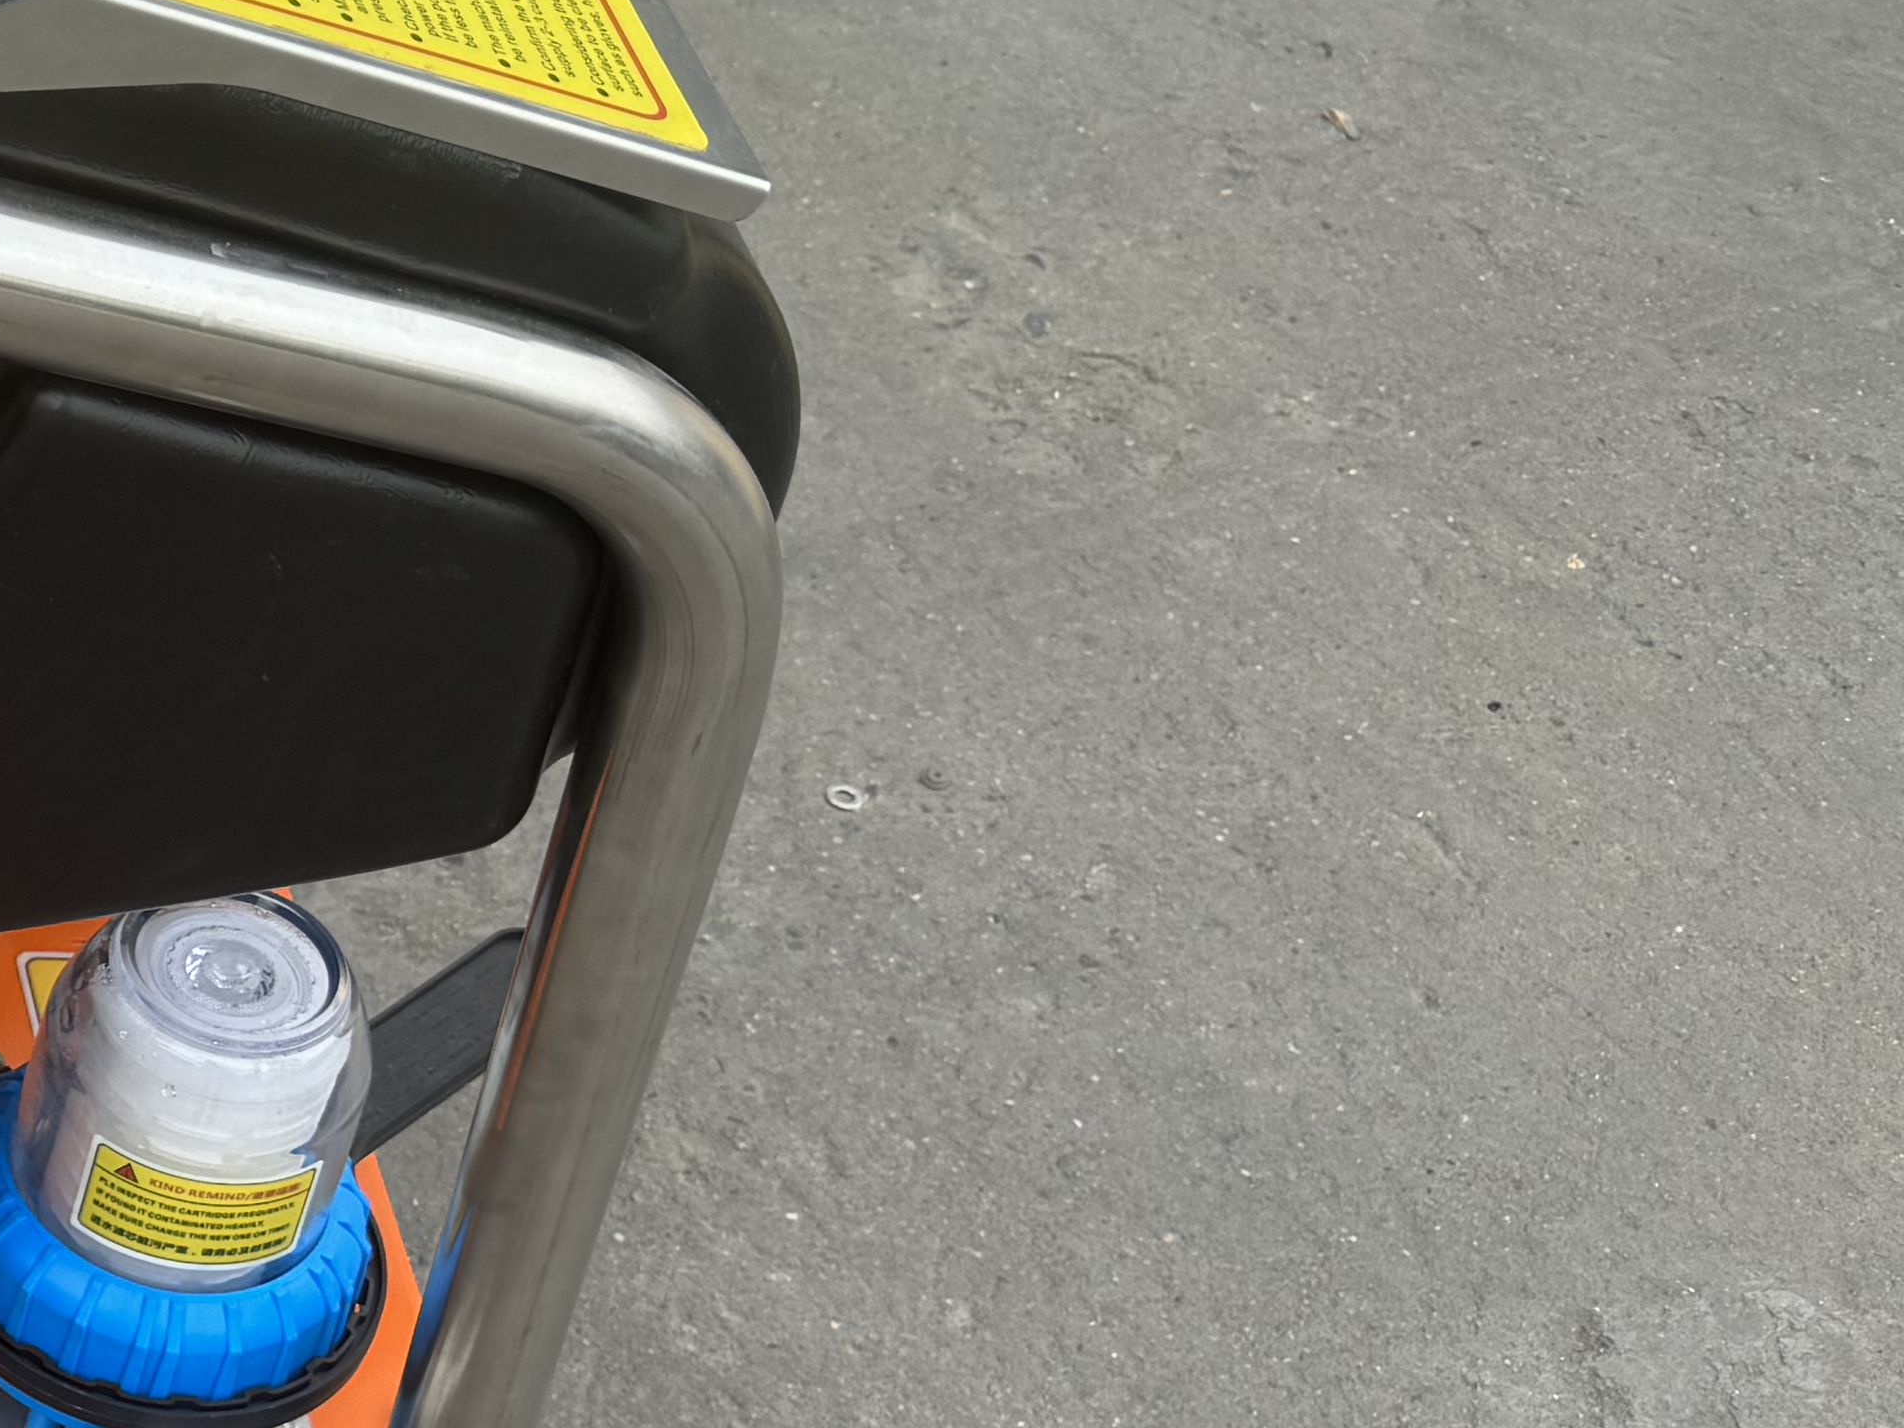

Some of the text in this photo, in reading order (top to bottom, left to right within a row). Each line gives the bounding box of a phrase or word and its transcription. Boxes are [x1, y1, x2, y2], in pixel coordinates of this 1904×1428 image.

[449, 7, 468, 31] less
[462, 33, 478, 48] be
[116, 1184, 155, 1205] INSPECT
[159, 1201, 177, 1212] THE
[179, 1207, 235, 1218] CARTRIDGE
[149, 1179, 184, 1194] KIND
[93, 1199, 117, 1215] MAKE
[119, 1211, 143, 1225] SURE
[145, 1222, 186, 1238] CHANGE
[189, 1232, 208, 1240] THE
[210, 1232, 230, 1240] NEW
[232, 1230, 252, 1239] ONE
[253, 1229, 266, 1238] ON
[105, 1192, 136, 1210] FOUND
[138, 1207, 147, 1215] IT
[148, 1211, 223, 1229] CONTAMINATED
